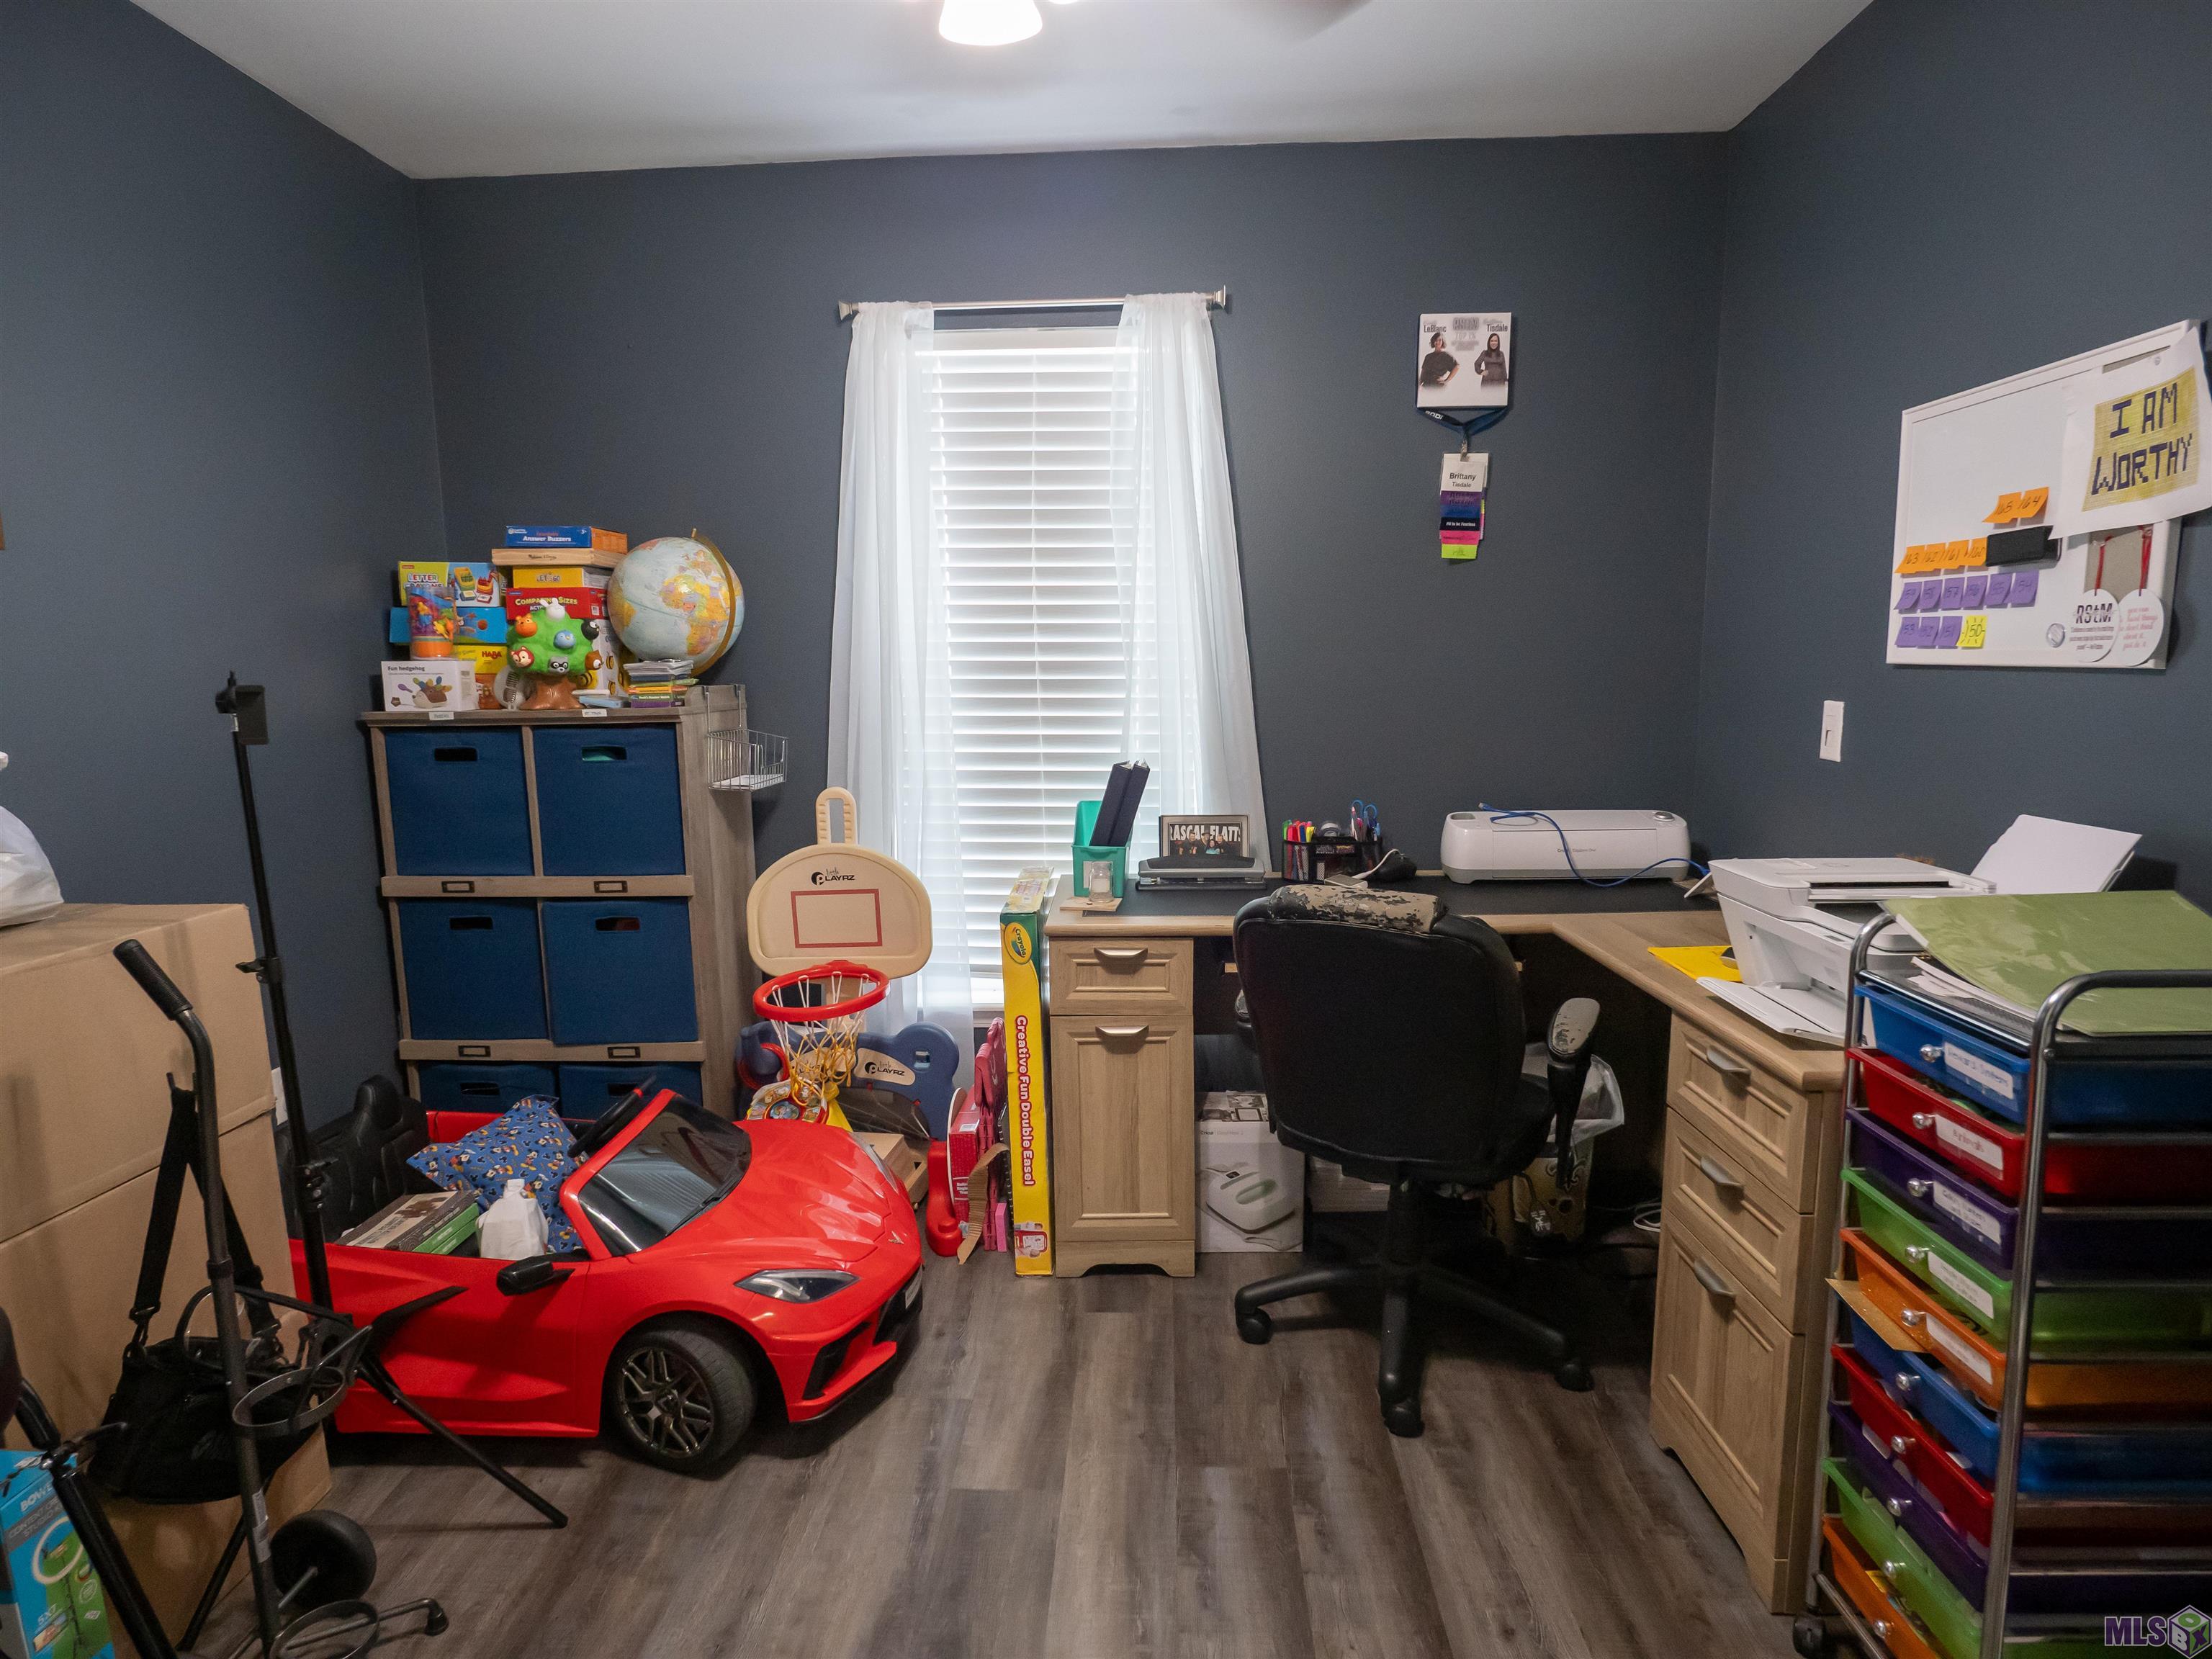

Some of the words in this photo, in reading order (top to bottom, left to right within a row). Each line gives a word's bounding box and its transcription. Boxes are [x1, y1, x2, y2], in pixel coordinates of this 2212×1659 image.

[2110, 399, 2132, 439] I
[2141, 382, 2177, 434] AM
[1449, 472, 1476, 481] Brittany
[2091, 433, 2193, 495] WORTHY
[408, 573, 438, 582] LETTER
[482, 651, 502, 660] HABA
[1015, 927, 1027, 958] Crayola
[1016, 1015, 1030, 1074] Creative
[1019, 1075, 1030, 1100] Fun
[1020, 1102, 1033, 1148] Double
[1022, 1150, 1035, 1184] Easel
